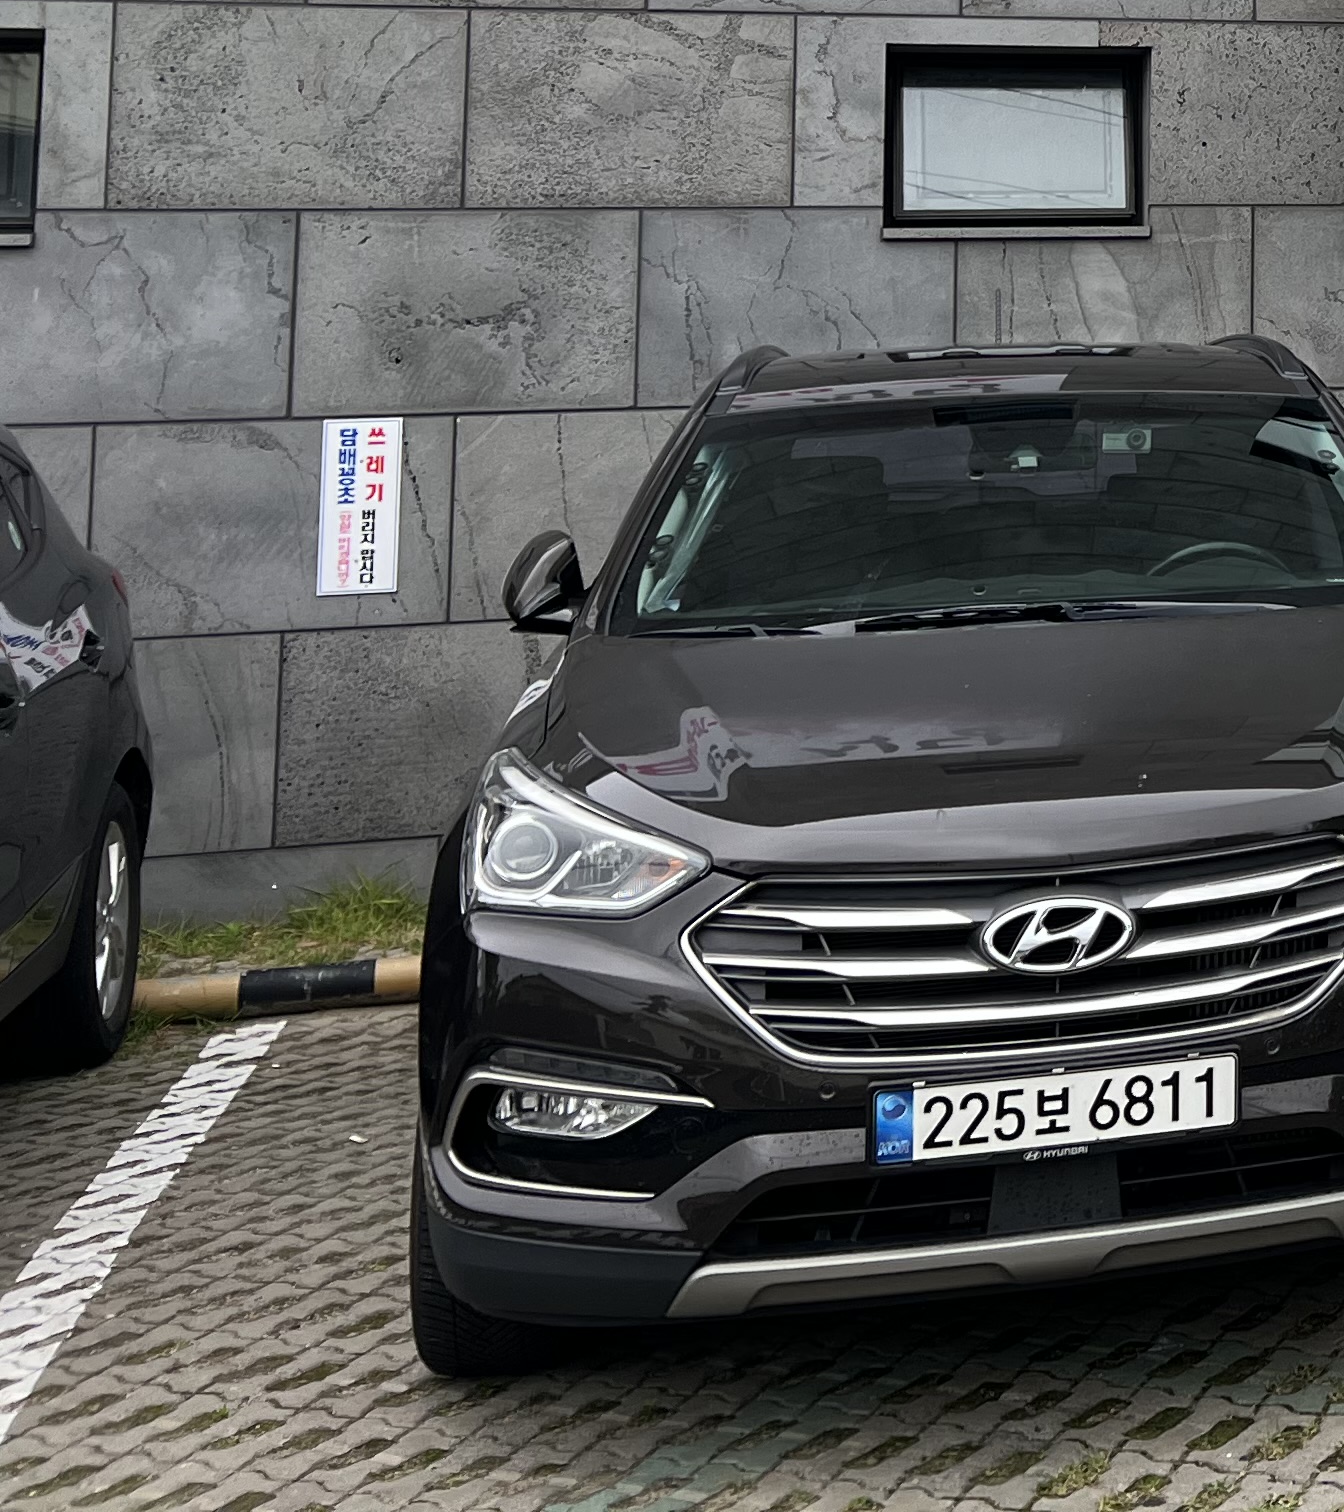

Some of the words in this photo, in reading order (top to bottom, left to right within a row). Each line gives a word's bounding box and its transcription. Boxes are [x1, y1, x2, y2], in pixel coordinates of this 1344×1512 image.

[337, 427, 359, 505] 담배꽁초
[366, 427, 385, 502] 쓰레기
[359, 508, 376, 545] 버리지
[922, 1086, 1071, 1150] 225보
[1088, 1066, 1215, 1131] 6811
[1042, 1144, 1090, 1160] HYUNDAI
